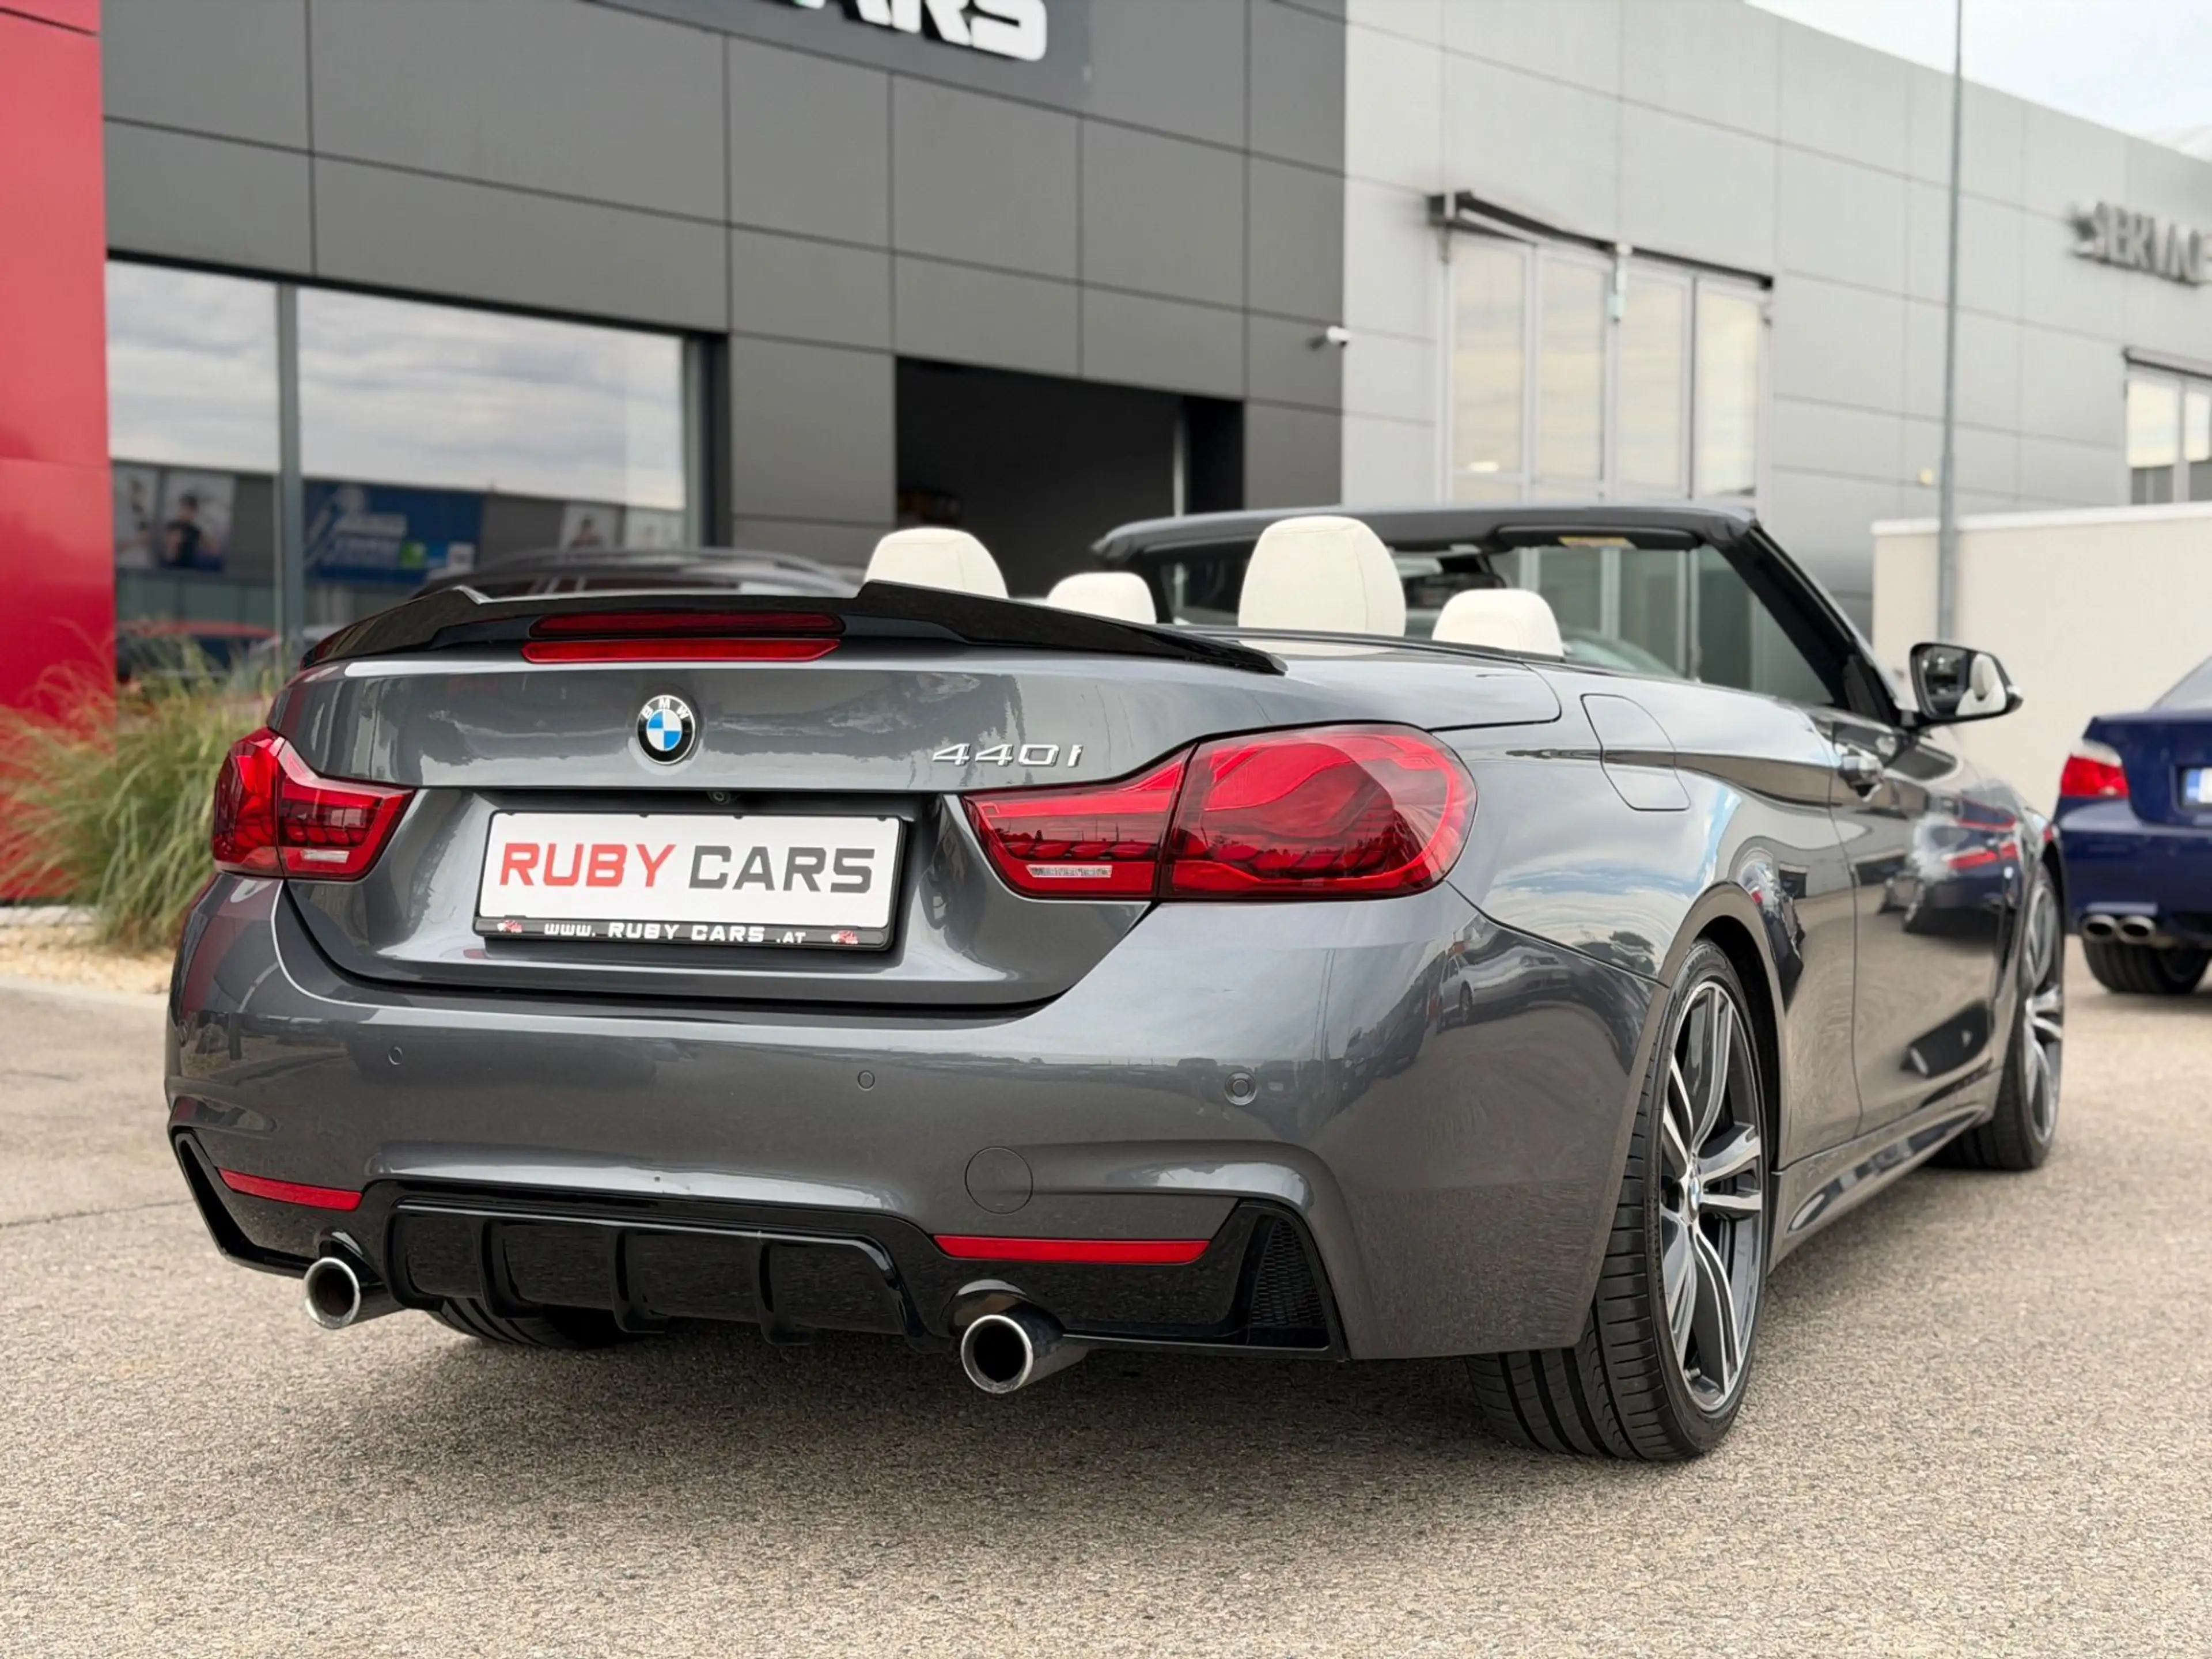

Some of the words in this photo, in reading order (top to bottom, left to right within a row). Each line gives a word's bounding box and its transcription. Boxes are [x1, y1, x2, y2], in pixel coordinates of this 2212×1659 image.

[640, 698, 690, 720] BMW
[932, 743, 1084, 768] 440i
[499, 843, 676, 887] RUBY
[688, 845, 875, 893] CARS
[608, 922, 680, 940] RUBY
[691, 925, 765, 942] CARS
